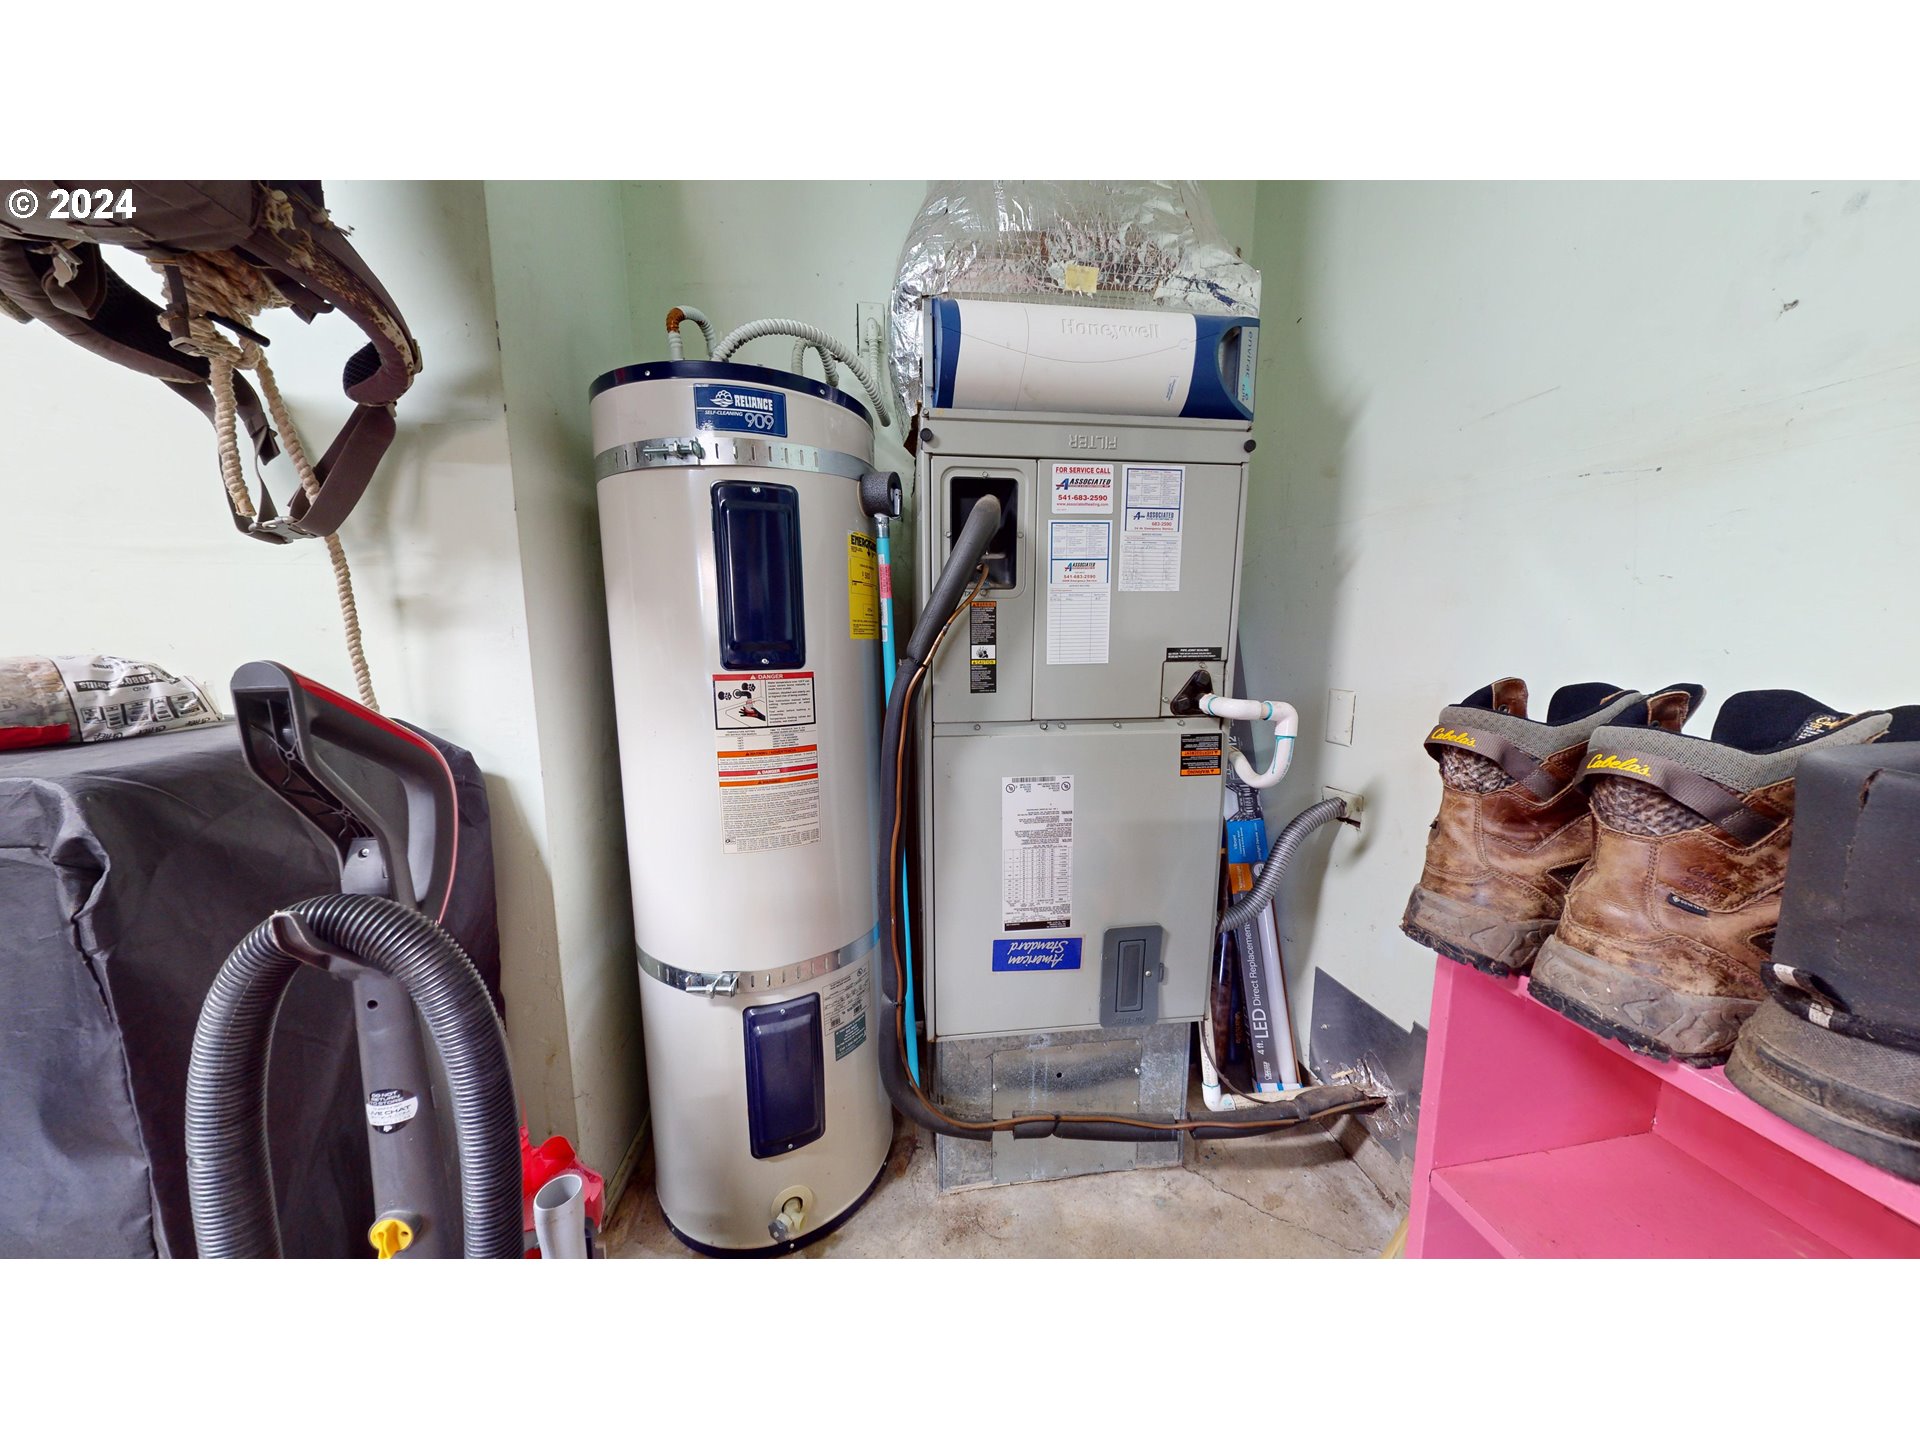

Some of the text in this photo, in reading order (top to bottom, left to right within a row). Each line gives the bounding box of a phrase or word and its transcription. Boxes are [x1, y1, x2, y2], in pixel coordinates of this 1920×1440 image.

[1060, 318, 1160, 339] Honeywell
[734, 394, 773, 411] RELIANCE
[744, 412, 775, 430] 909
[1068, 434, 1118, 450] FILTER
[1431, 728, 1476, 748] Cabela's
[1586, 754, 1651, 776] Cabela's
[1007, 940, 1069, 955] Standard
[1007, 953, 1064, 968] American
[1251, 980, 1262, 1006] Direct
[1252, 1008, 1269, 1039] LED
[385, 1104, 411, 1115] CHAT
